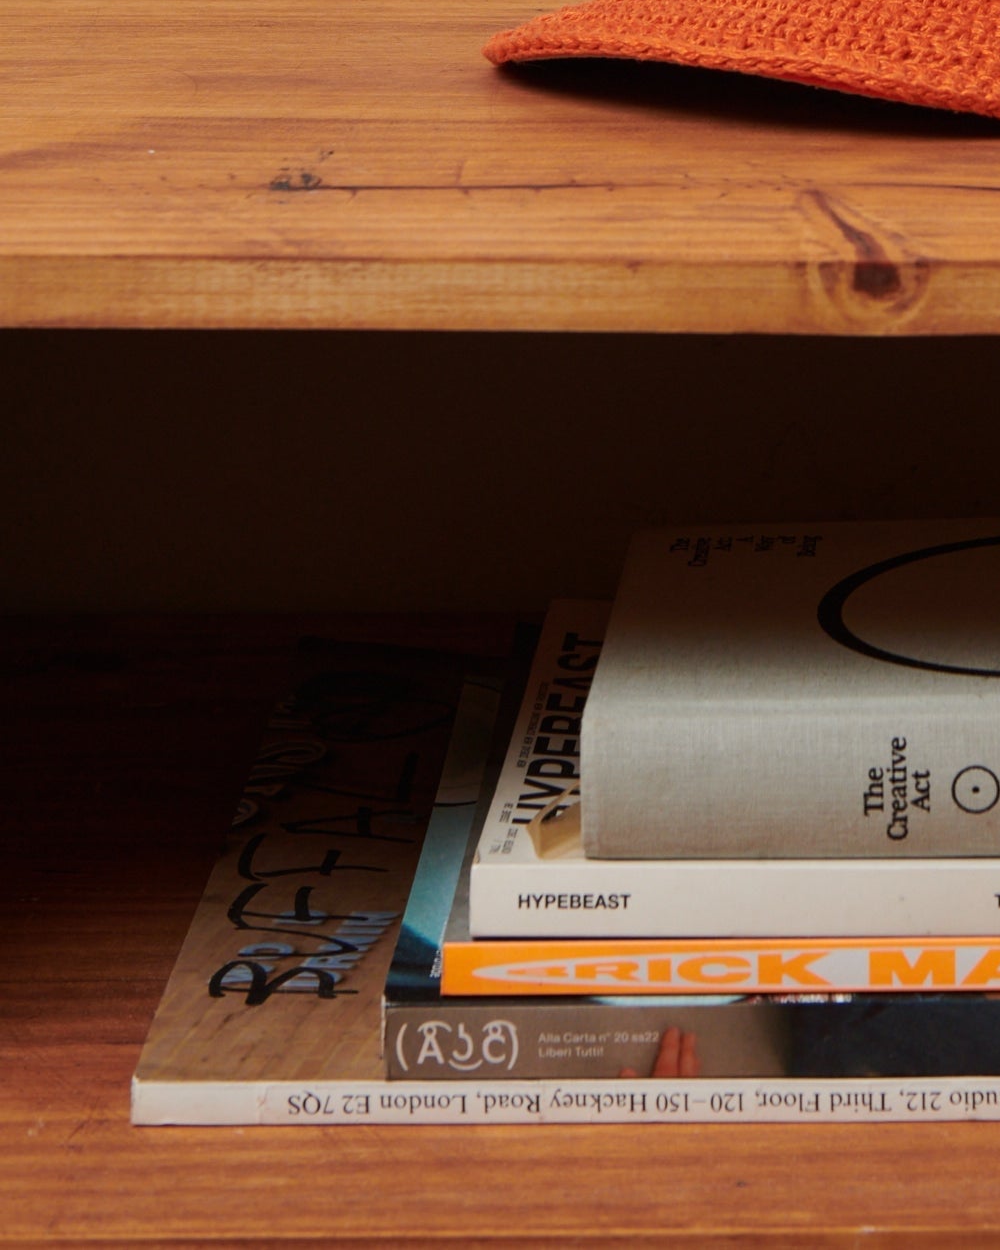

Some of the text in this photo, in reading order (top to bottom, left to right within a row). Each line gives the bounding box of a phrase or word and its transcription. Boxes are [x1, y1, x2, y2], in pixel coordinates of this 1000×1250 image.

[863, 766, 885, 818] The
[886, 735, 909, 841] Creative
[910, 768, 931, 814] Act
[518, 893, 631, 910] HYPEBEAST
[505, 951, 834, 987] BRICK
[538, 1032, 561, 1044] Alla
[562, 1032, 597, 1044] Carta
[613, 1031, 630, 1043] 20
[538, 1046, 572, 1058] Liberi
[287, 1091, 334, 1116] 7QS
[342, 1094, 370, 1115] E2
[380, 1094, 467, 1116] London
[476, 1092, 543, 1116] Road,
[549, 1088, 647, 1114] Hackney
[755, 1091, 820, 1114] Floor,
[829, 1092, 892, 1114] Third
